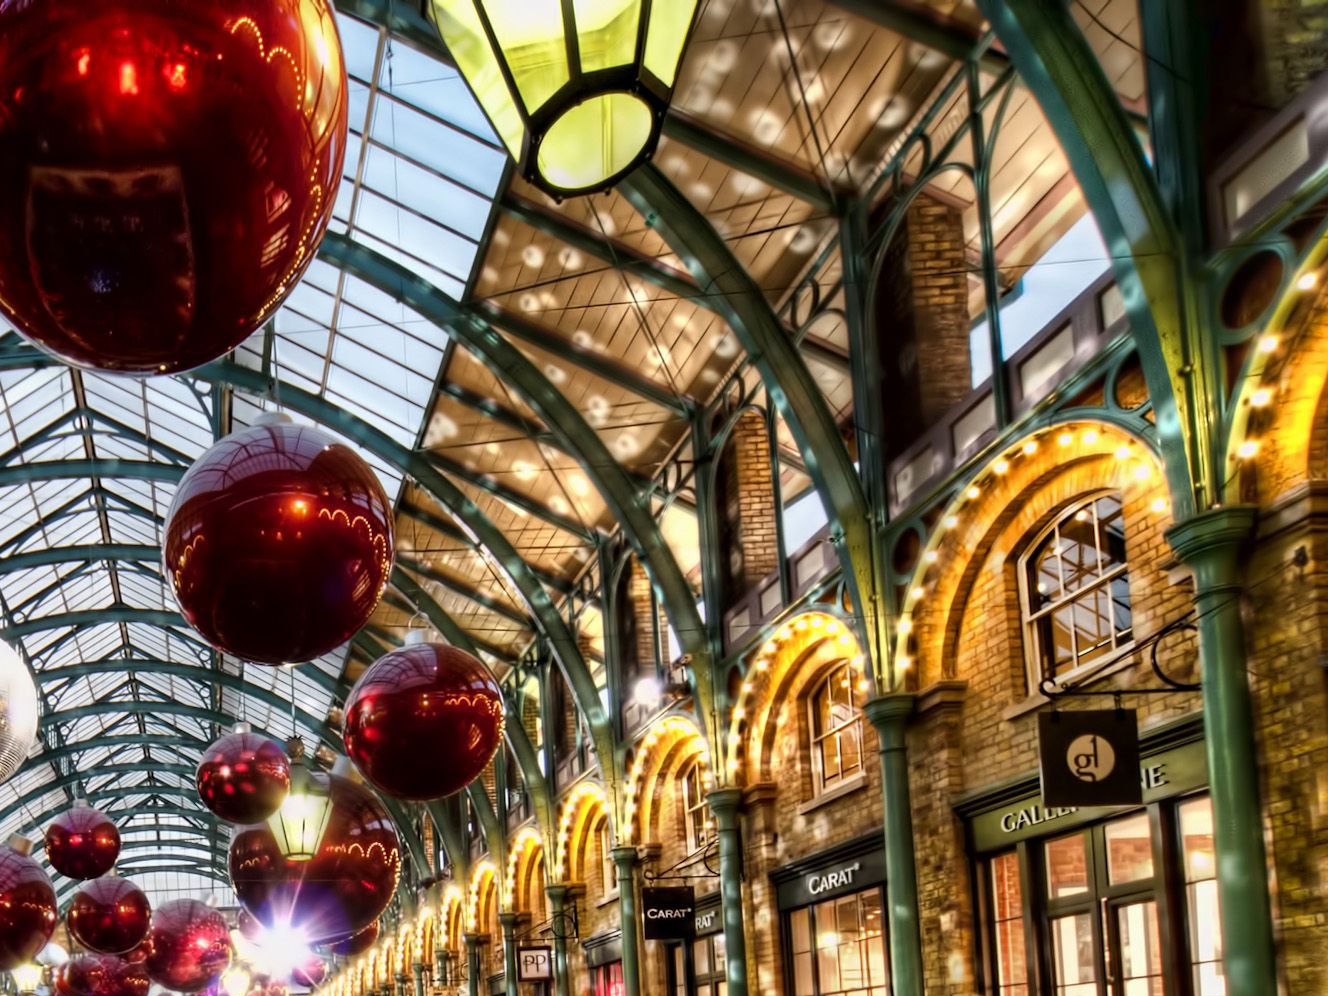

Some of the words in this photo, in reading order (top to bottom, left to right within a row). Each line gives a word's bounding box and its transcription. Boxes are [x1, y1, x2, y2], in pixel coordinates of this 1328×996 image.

[808, 866, 855, 895] CARAT
[647, 908, 687, 919] CARAT
[695, 913, 711, 929] RAT
